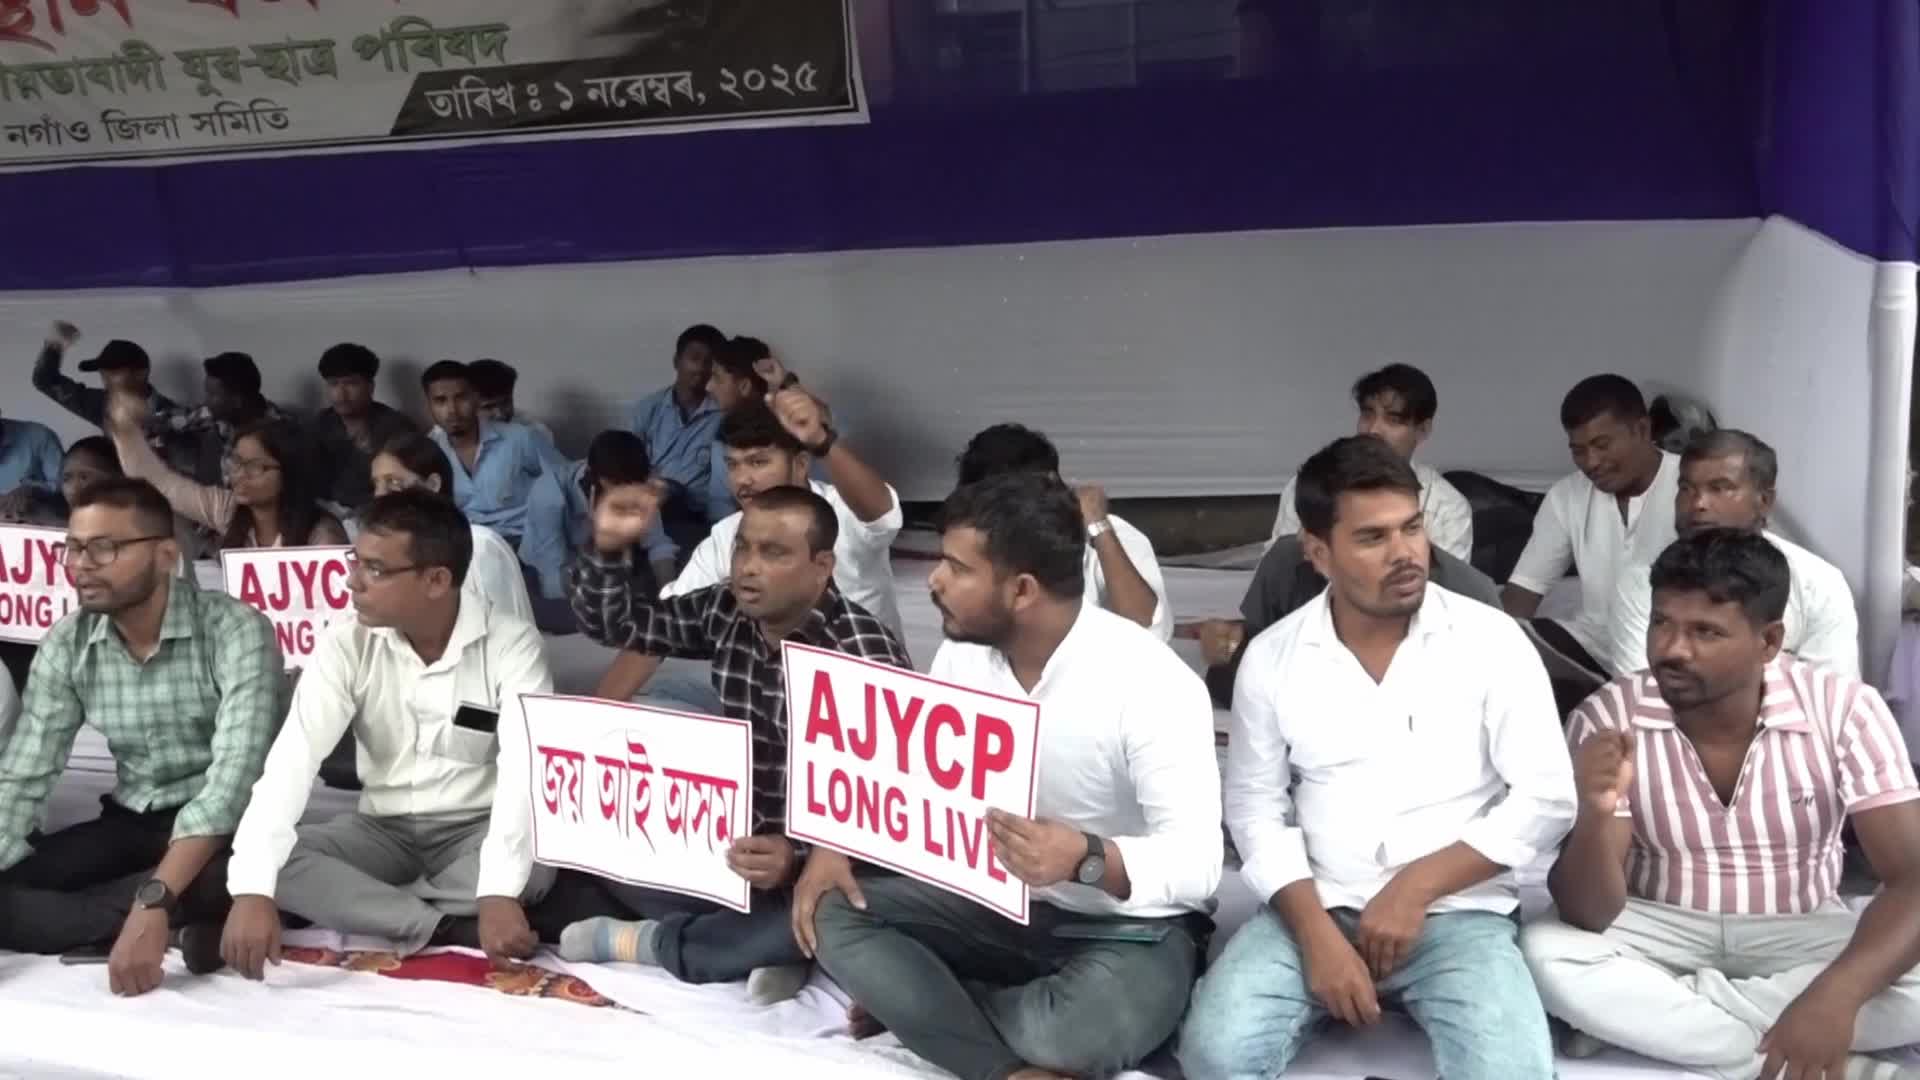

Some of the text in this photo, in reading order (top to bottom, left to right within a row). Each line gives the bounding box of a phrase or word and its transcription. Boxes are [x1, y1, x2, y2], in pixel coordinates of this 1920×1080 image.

[719, 60, 819, 99] ২০২৫
[101, 108, 180, 143] জিলা
[189, 98, 290, 137] সমিতি
[0, 538, 77, 588] JY
[805, 669, 1015, 801] AJYCP
[537, 728, 739, 856] জয় আই অসম
[807, 761, 908, 843] LONG
